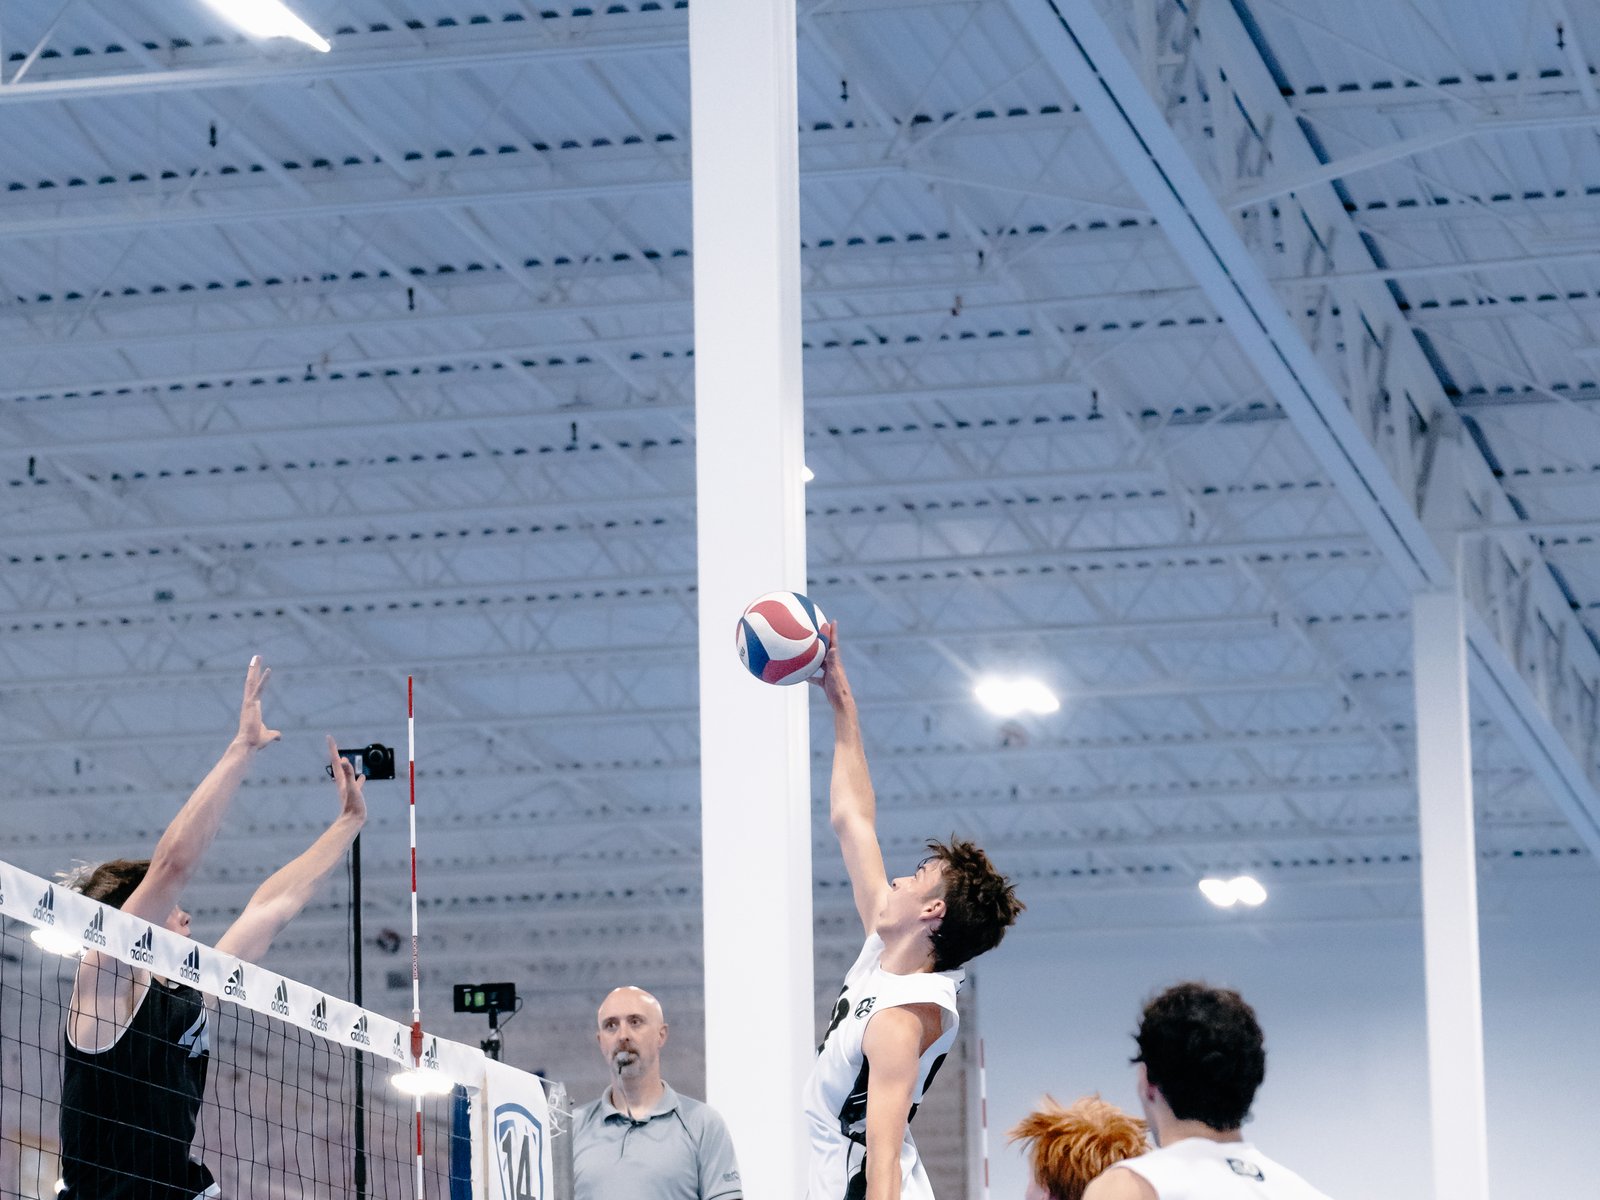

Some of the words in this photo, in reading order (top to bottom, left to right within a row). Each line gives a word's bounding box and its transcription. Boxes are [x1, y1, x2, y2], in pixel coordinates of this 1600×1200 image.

[33, 907, 55, 926] adidas
[83, 928, 107, 947] adidas
[130, 947, 154, 965] adidas
[180, 965, 200, 984] adidas
